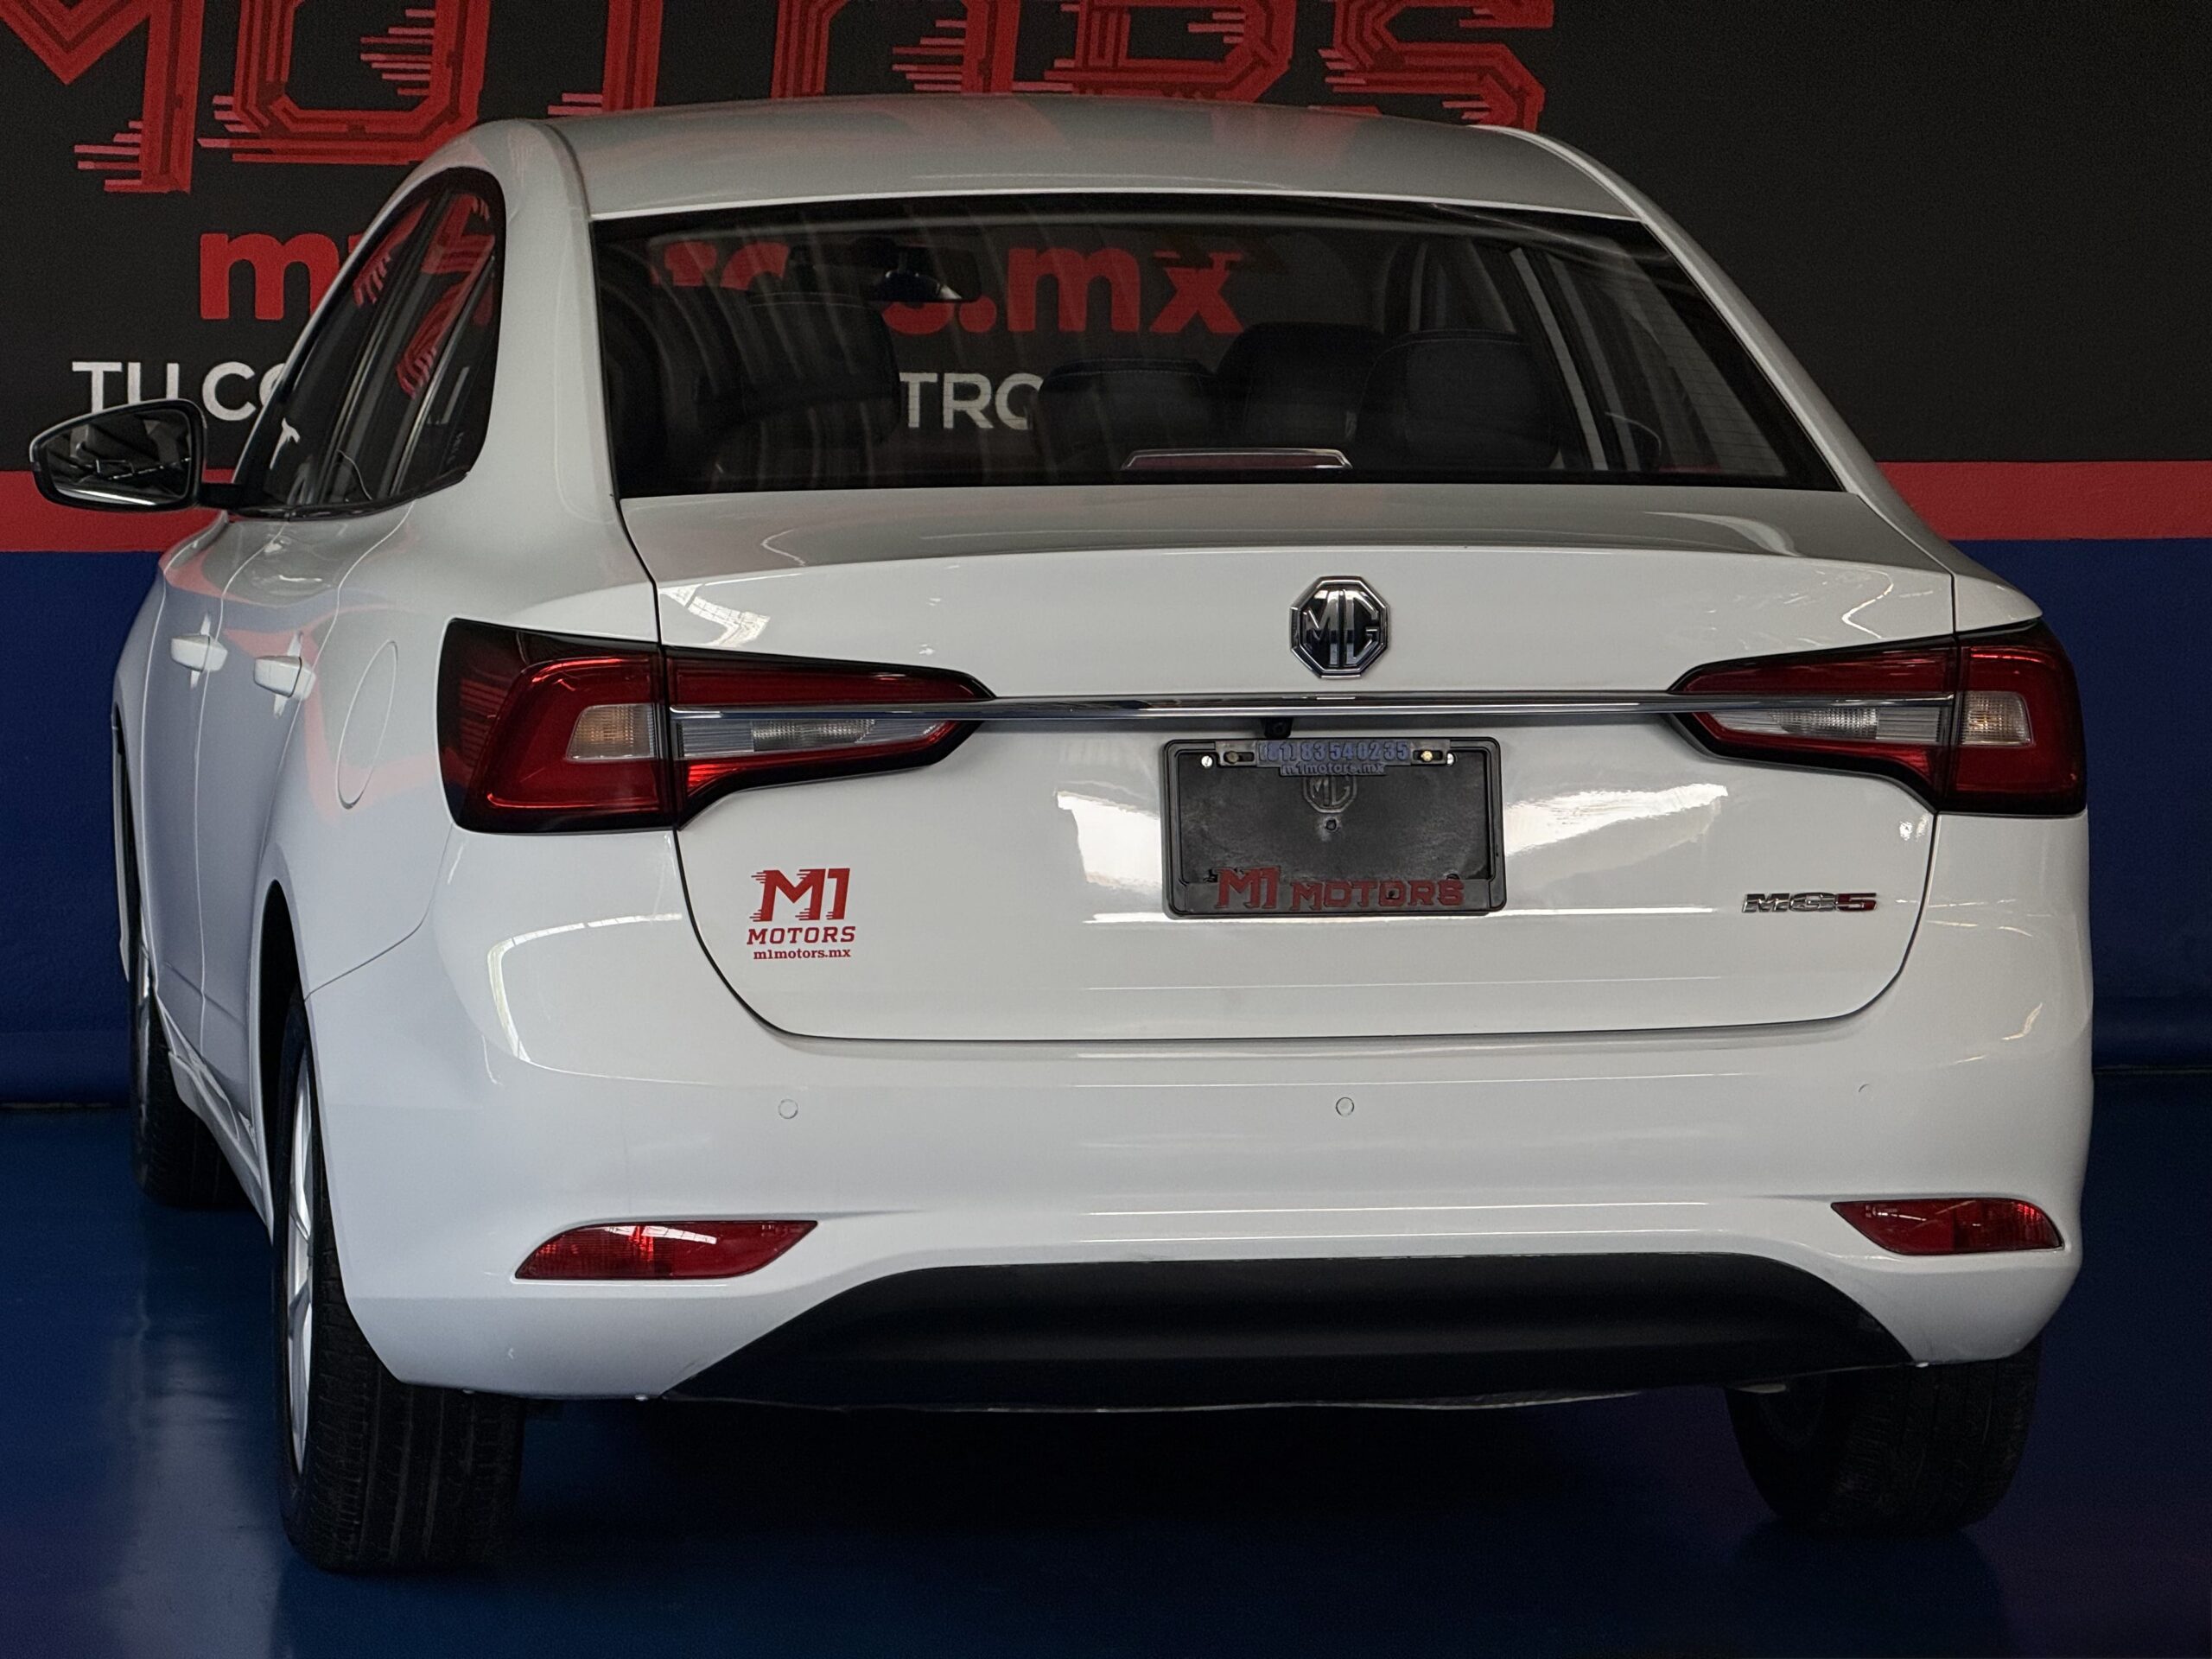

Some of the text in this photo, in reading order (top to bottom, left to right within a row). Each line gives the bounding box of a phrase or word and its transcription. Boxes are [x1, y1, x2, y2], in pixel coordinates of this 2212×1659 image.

[1300, 587, 1382, 668] MG
[749, 868, 851, 922] M1
[1214, 867, 1465, 911] M1 MOTORS
[1741, 892, 1878, 913] MG5
[747, 925, 856, 945] MOTORS
[753, 948, 852, 960] m1motors.mx
